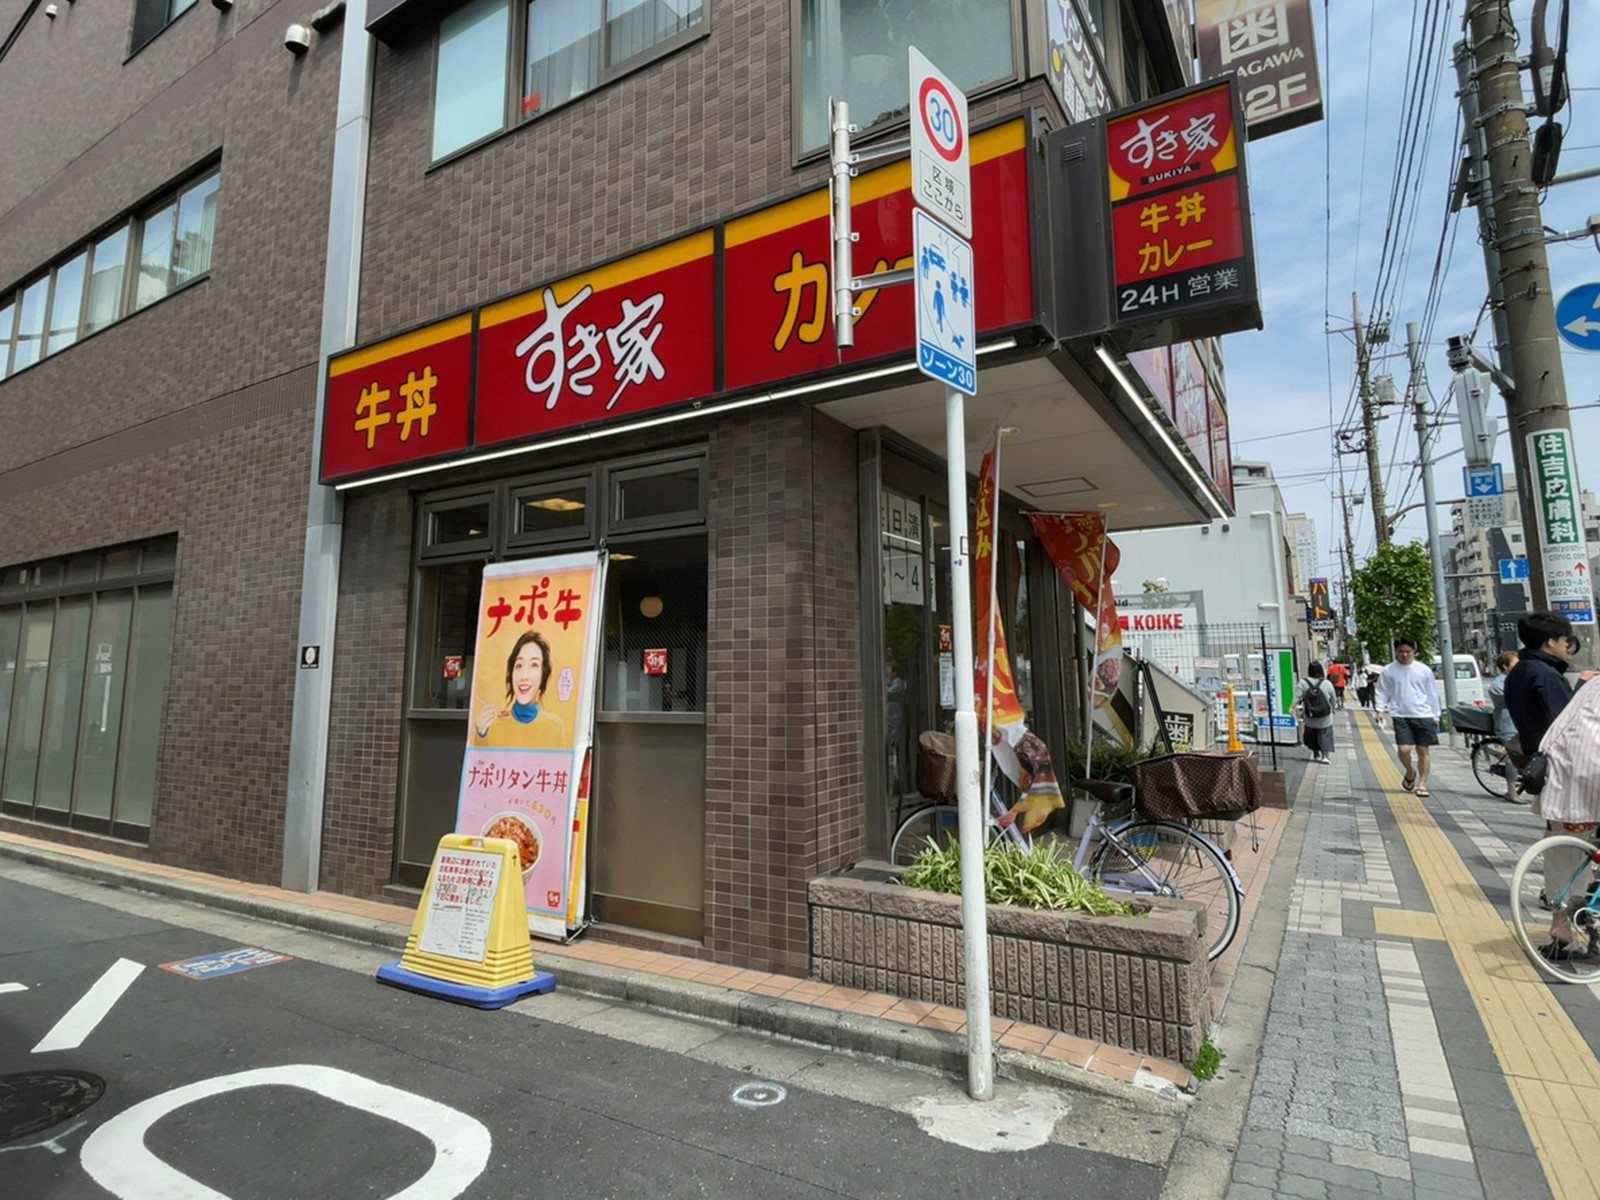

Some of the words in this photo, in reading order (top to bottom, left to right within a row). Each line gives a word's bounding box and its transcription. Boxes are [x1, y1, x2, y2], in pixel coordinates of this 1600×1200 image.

[1246, 73, 1307, 118] 2F
[930, 97, 954, 143] 30
[1120, 113, 1219, 169] すき家
[932, 165, 955, 196] 区域
[1148, 165, 1192, 183] SUKIYA
[923, 179, 964, 221] ここから
[1140, 191, 1207, 233] 牛丼
[1138, 238, 1213, 274] カレー
[515, 284, 665, 411] すき家
[922, 348, 973, 388] ゾーン30
[354, 364, 438, 450] 牛丼
[1538, 435, 1576, 542] 住吉皮膚科
[1548, 570, 1574, 579] この先
[487, 576, 582, 638] ナポ牛
[1134, 613, 1184, 630] KOIKE
[468, 763, 568, 793] ナポリタン牛丼
